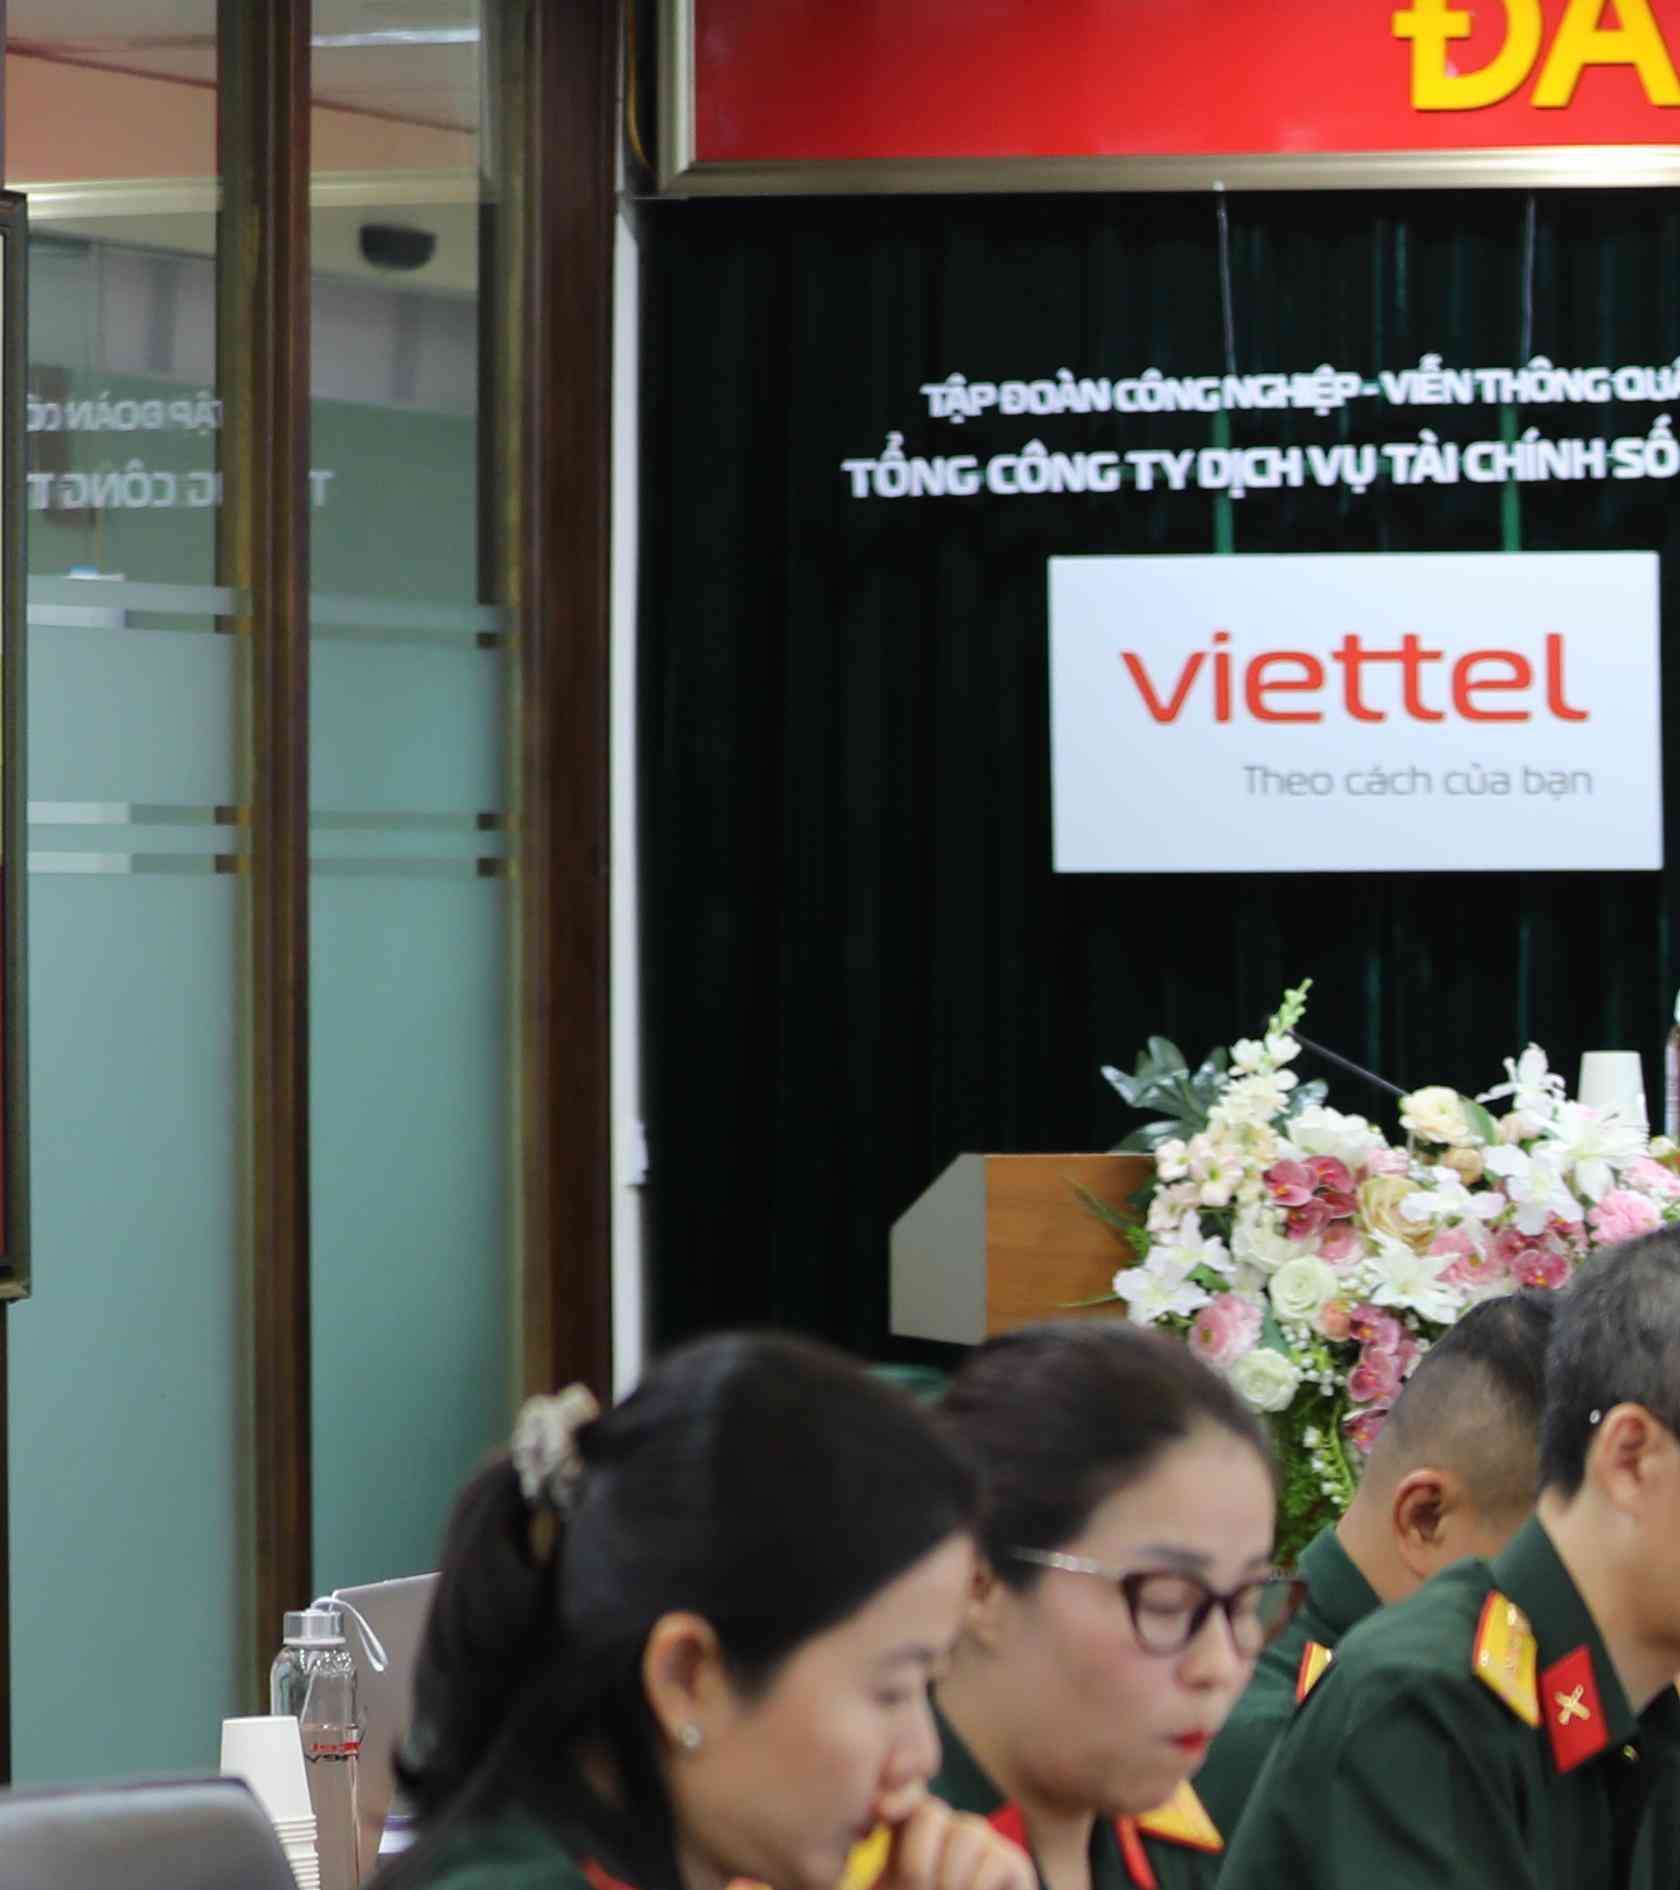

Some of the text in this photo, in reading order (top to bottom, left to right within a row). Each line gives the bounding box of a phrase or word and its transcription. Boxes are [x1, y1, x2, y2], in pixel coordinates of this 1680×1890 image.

[921, 372, 998, 424] TẬP
[999, 367, 1111, 415] ĐOÀN
[1112, 367, 1219, 413] CÔNG
[1220, 363, 1360, 416] NGHIỆP
[1474, 355, 1612, 404] THÔNG
[841, 430, 979, 498] TỔNG
[986, 438, 1121, 495] CÔNG
[1124, 449, 1195, 491] TY
[1197, 446, 1304, 499] DỊCH
[1306, 444, 1377, 494] VỤ
[1381, 428, 1459, 484] TÀI
[1463, 427, 1605, 482] CHÍNH
[1119, 631, 1591, 725] viettel
[1242, 762, 1594, 801] Theo cách của bạn
